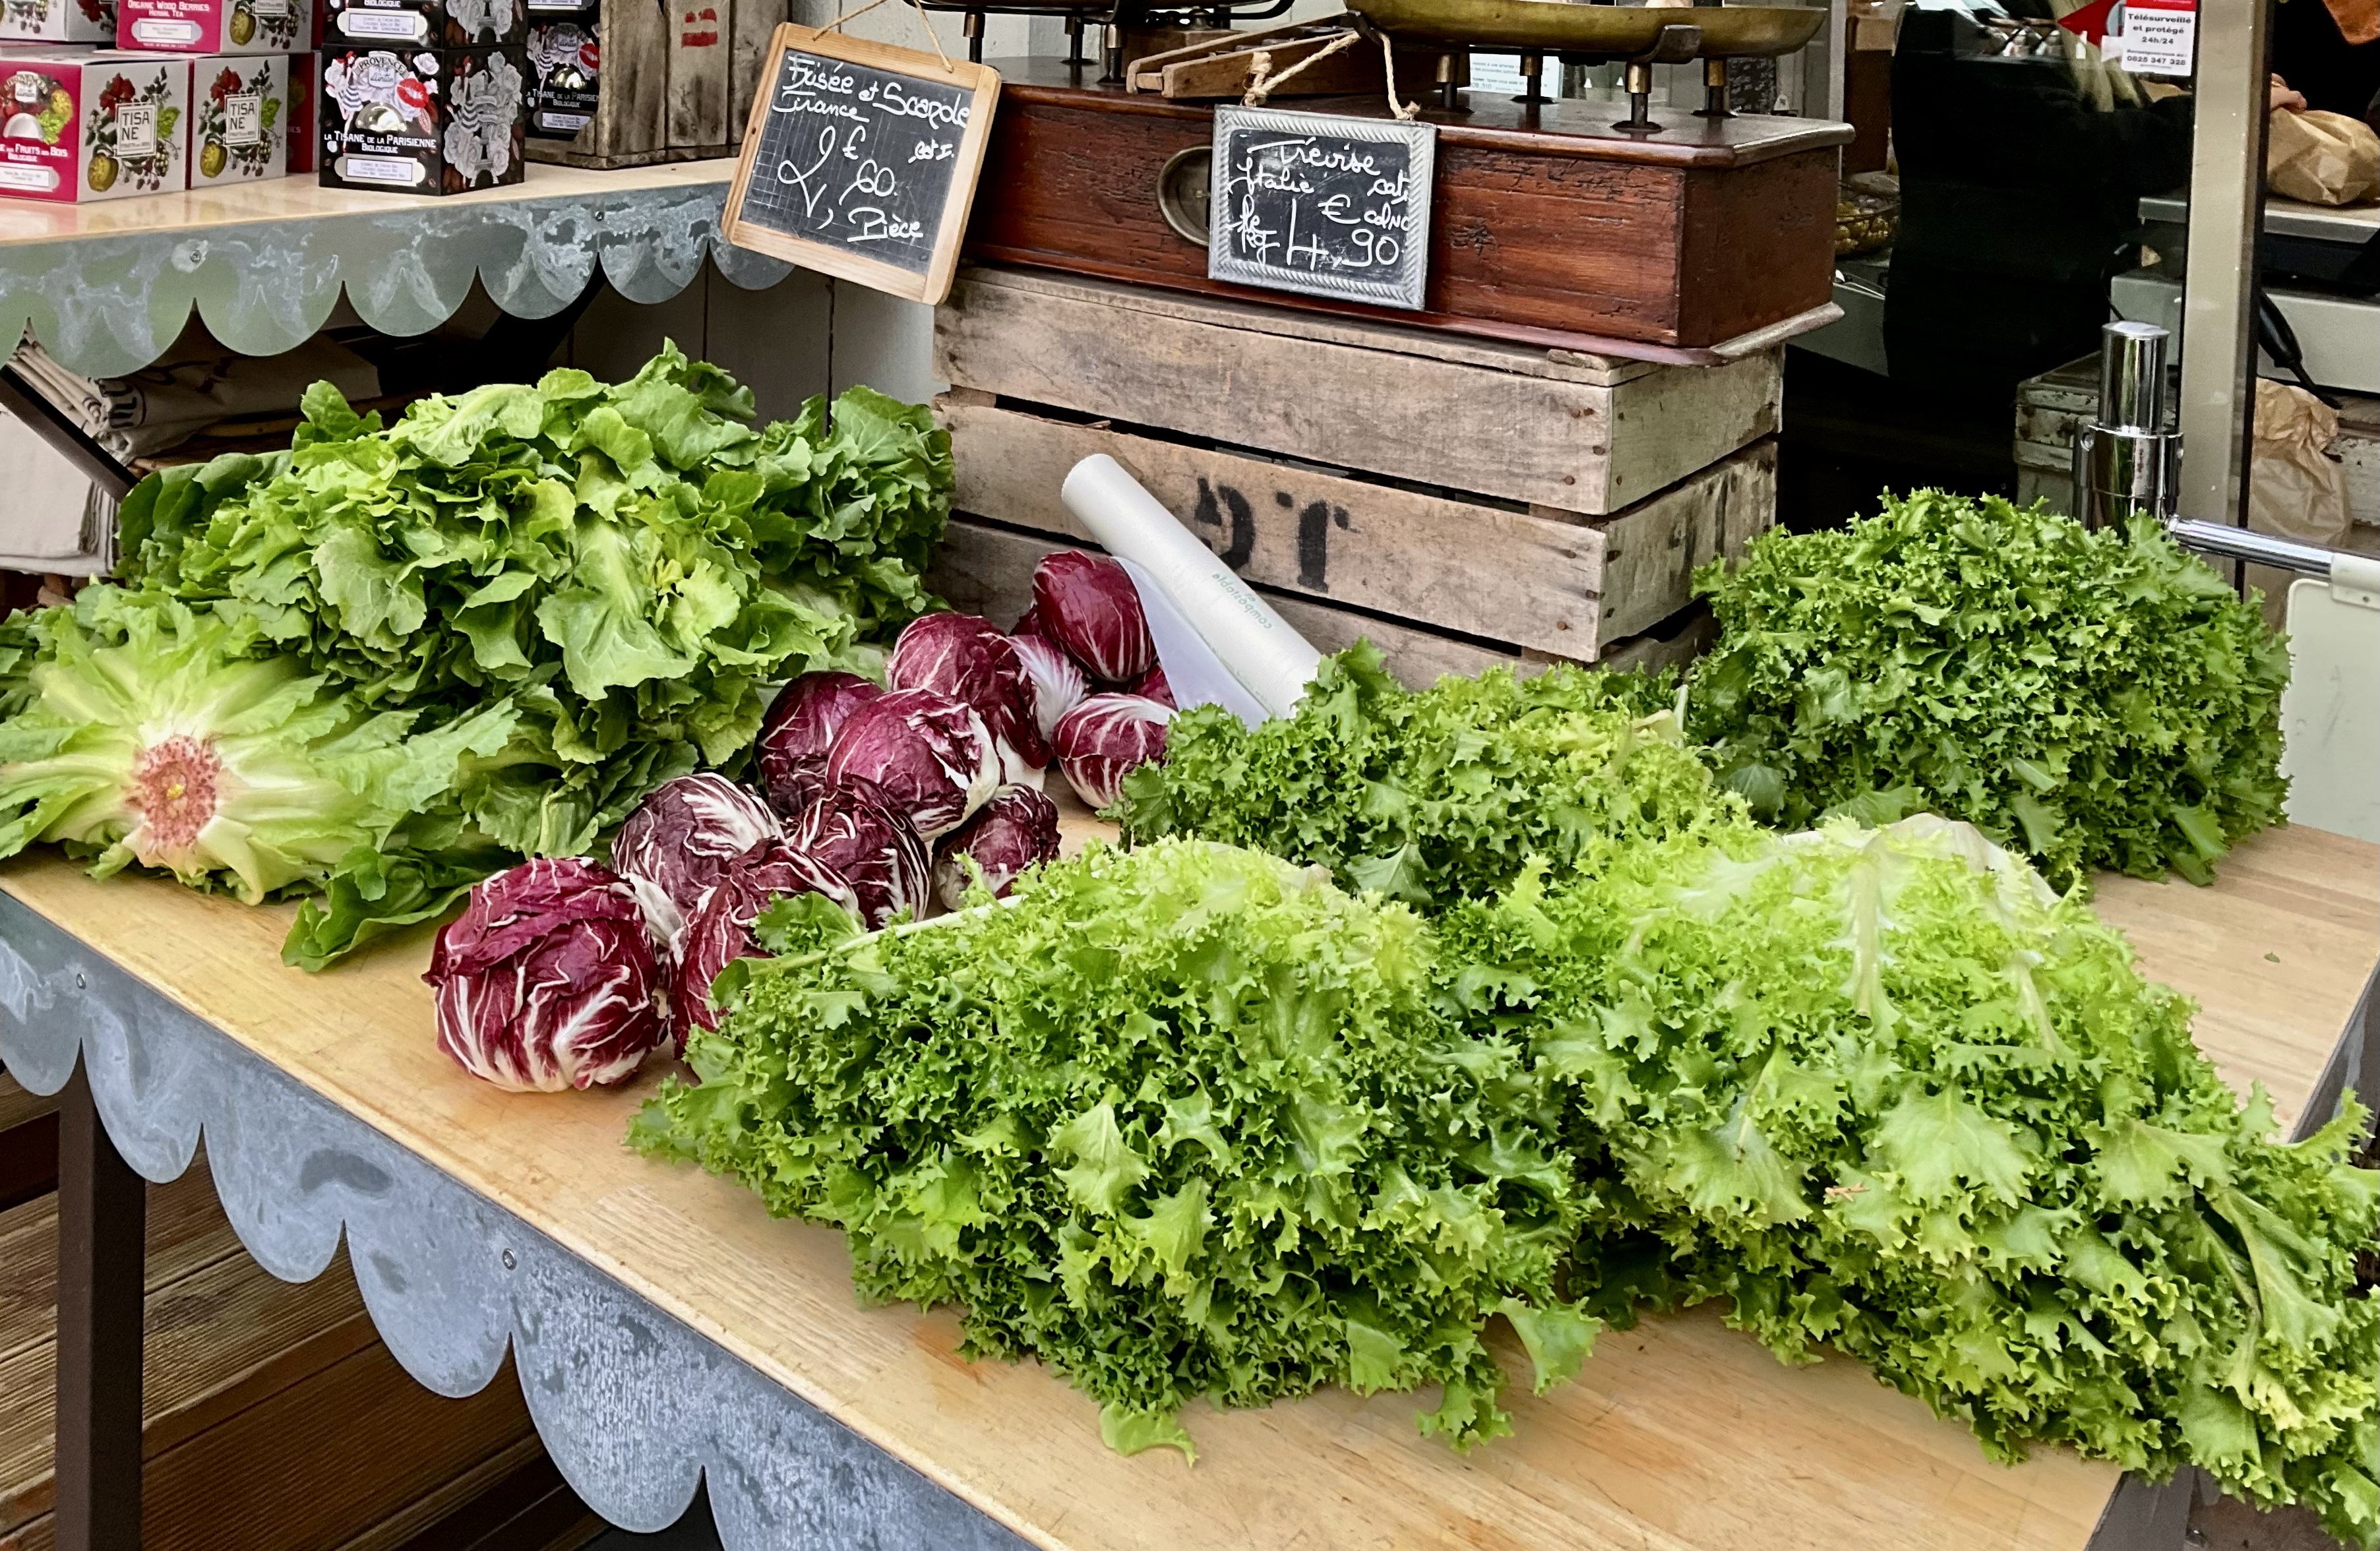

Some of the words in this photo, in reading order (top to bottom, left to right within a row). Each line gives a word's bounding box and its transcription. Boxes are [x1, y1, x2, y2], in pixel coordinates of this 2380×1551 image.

[178, 2, 210, 12] BERRIES
[2127, 13, 2191, 24] Télésurveillé
[2145, 26, 2185, 35] protégé
[2142, 36, 2174, 45] 24h/24
[359, 56, 405, 74] PROVENCE
[532, 88, 555, 99] TISANE
[859, 80, 879, 102] et
[231, 102, 255, 115] TISA
[122, 111, 150, 126] TISA
[231, 117, 245, 130] NE
[121, 127, 138, 141] NE
[334, 131, 365, 143] TISANE
[386, 135, 437, 148] PARISIENNE
[15, 143, 40, 155] FRUITS
[50, 146, 68, 158] BOIS
[361, 143, 398, 154] BIOLOGIQUE
[847, 206, 923, 243] Pièce
